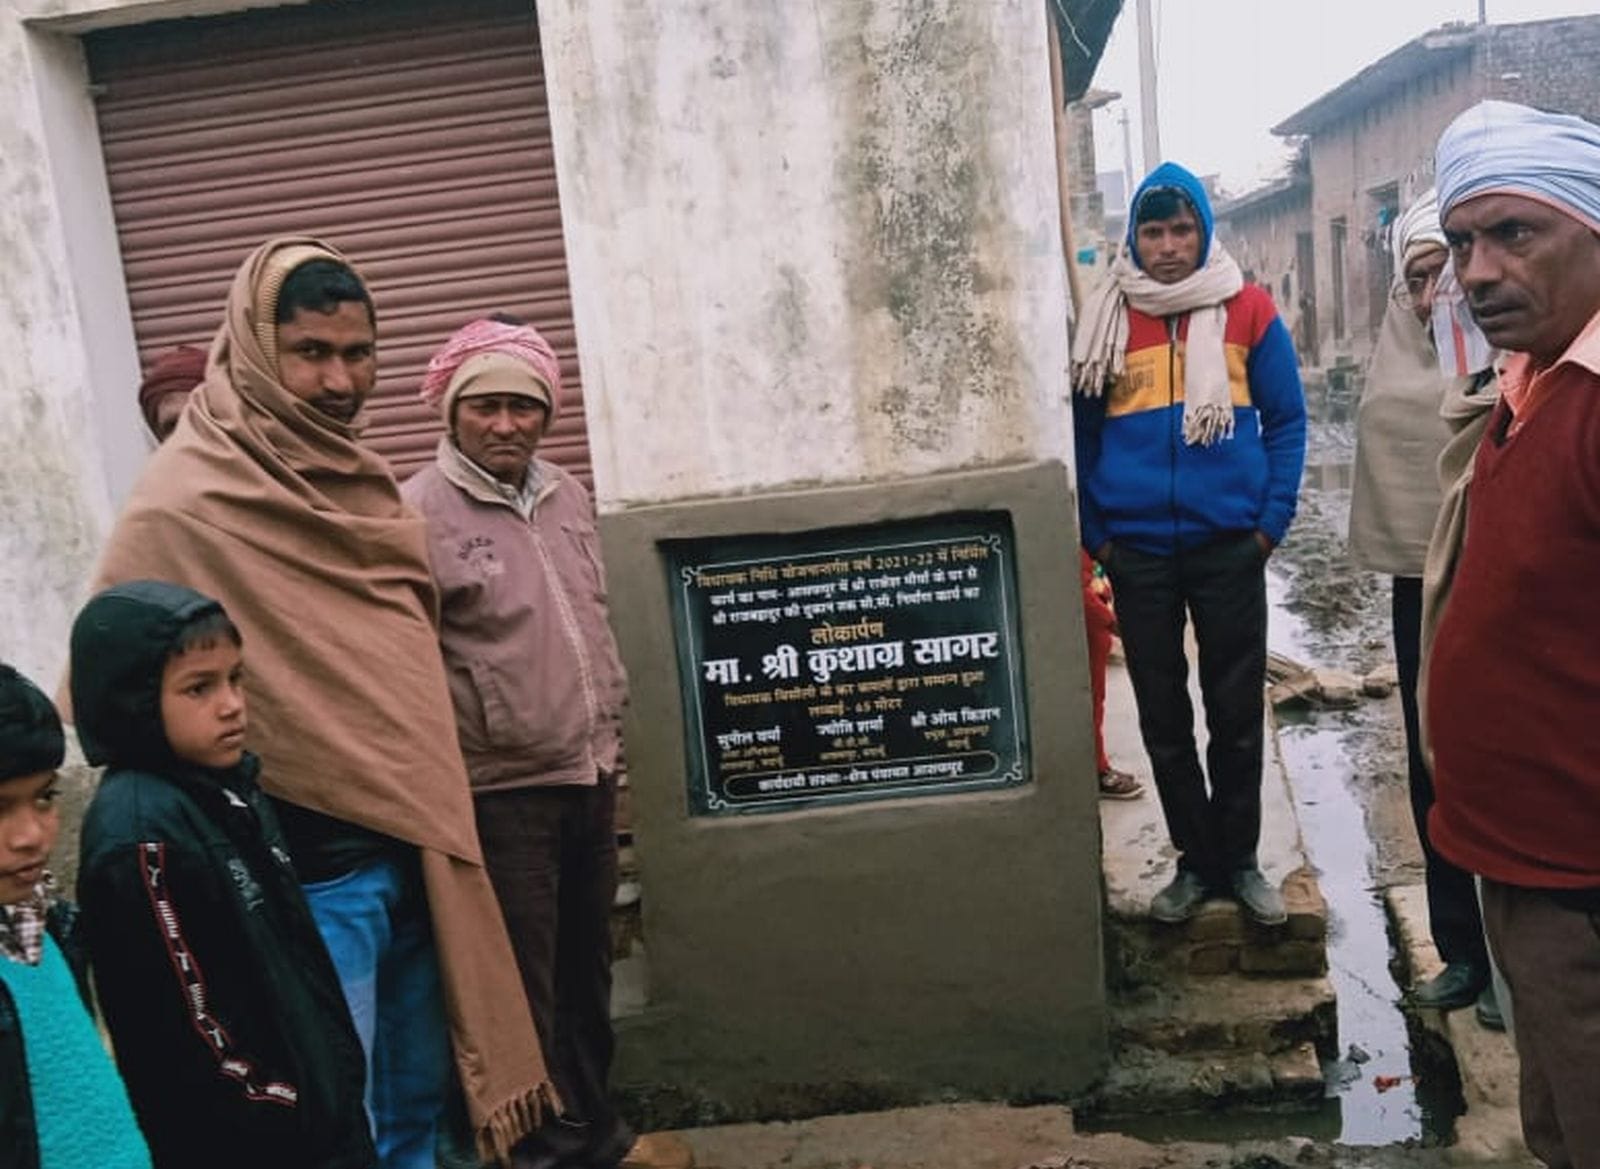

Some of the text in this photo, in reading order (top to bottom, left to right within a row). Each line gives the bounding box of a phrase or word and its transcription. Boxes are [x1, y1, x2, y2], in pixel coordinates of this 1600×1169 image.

[811, 616, 884, 644] लोकार्पण
[762, 644, 799, 679] श्री
[807, 641, 904, 682] कुशाग्र
[911, 632, 999, 664] सागर
